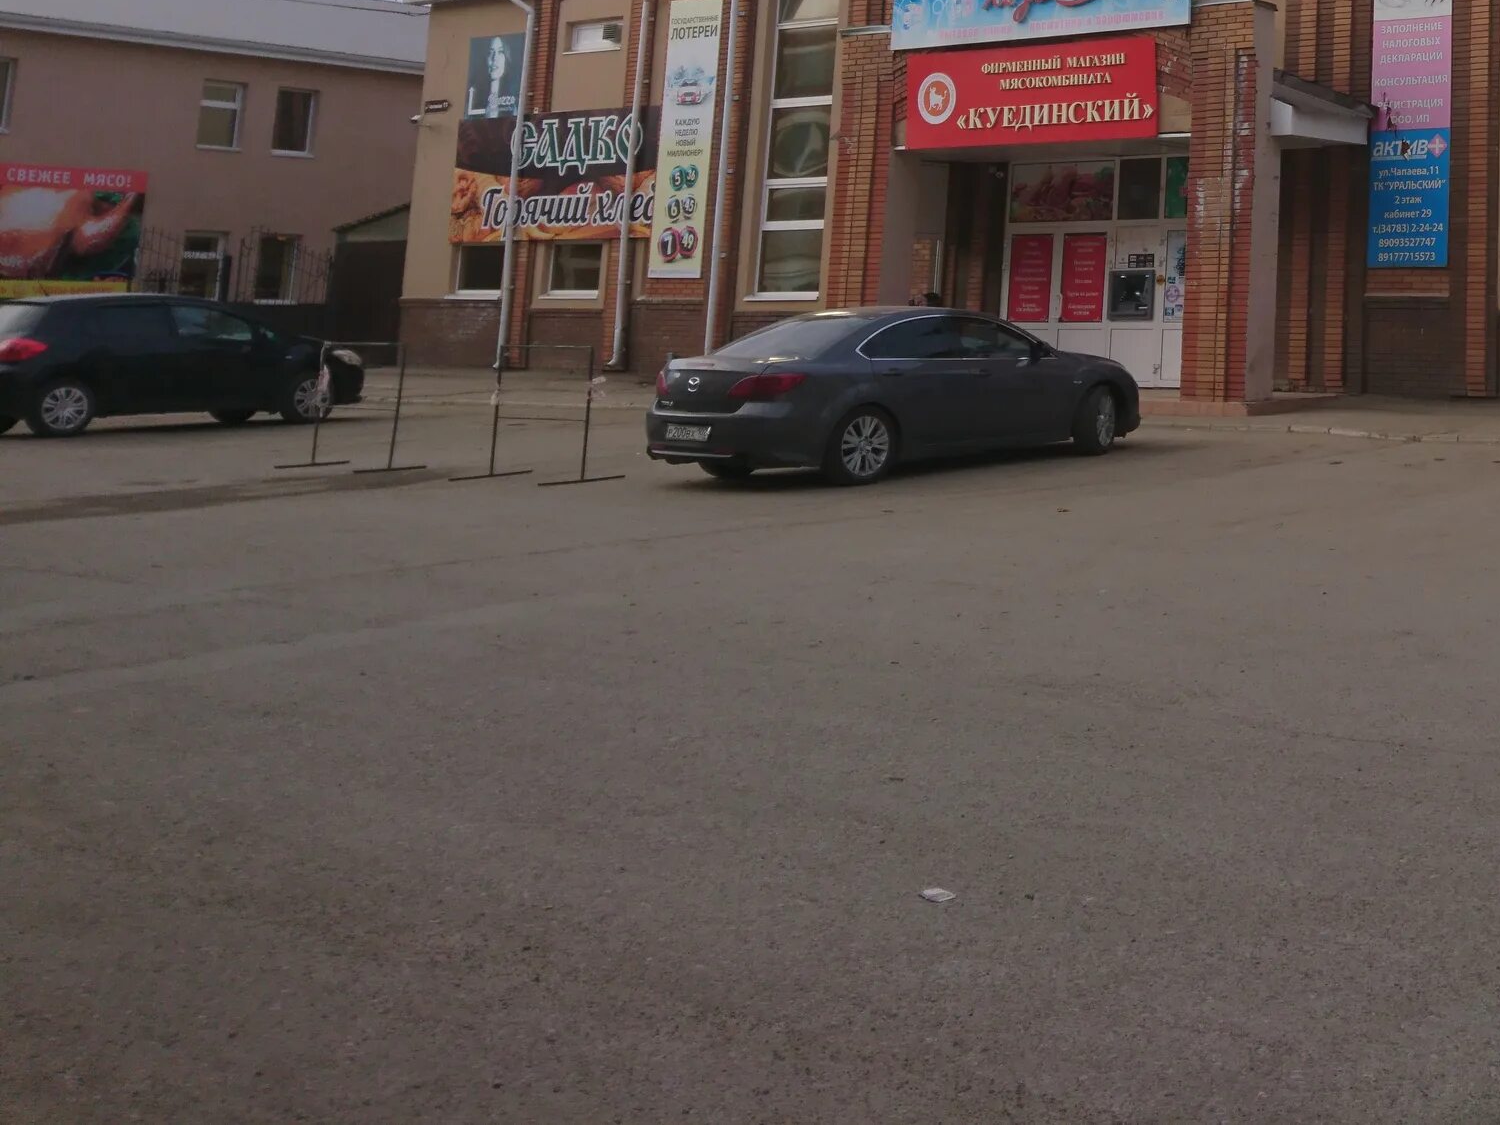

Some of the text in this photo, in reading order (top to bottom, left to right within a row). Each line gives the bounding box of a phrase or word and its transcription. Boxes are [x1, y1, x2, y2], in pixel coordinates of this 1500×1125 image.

[671, 15, 719, 24] ГОСУДАРСТВЕННЫЕ
[670, 25, 718, 40] ЛОТЕРЕИ
[1380, 22, 1443, 34] ЗАПОЛНЕНИЕ
[1382, 36, 1441, 48] НАЛОГОВЫХ
[981, 52, 1126, 75] ФИРМЕННЫЙ МАГАЗИН
[999, 72, 1112, 91] МЯСОКОМБИНАТА
[1374, 74, 1448, 87] КОНСУЛЬТАЦИЯ
[956, 92, 1155, 131] «КУЕДИНСКИЙ»
[674, 118, 700, 126] КАЖДУЮ
[1416, 114, 1430, 123] ИП
[674, 128, 699, 136] НЕДЕЛЮ
[511, 114, 643, 175] САДКО
[675, 138, 696, 146] НОВЫЙ
[6, 167, 132, 187] СВЕЖЕЕ МЯСО!
[1373, 181, 1384, 191] ТК
[1401, 195, 1422, 204] этаж
[480, 183, 594, 239] Горячий
[1384, 208, 1432, 219] кабинет 29
[664, 234, 695, 255] 7 49
